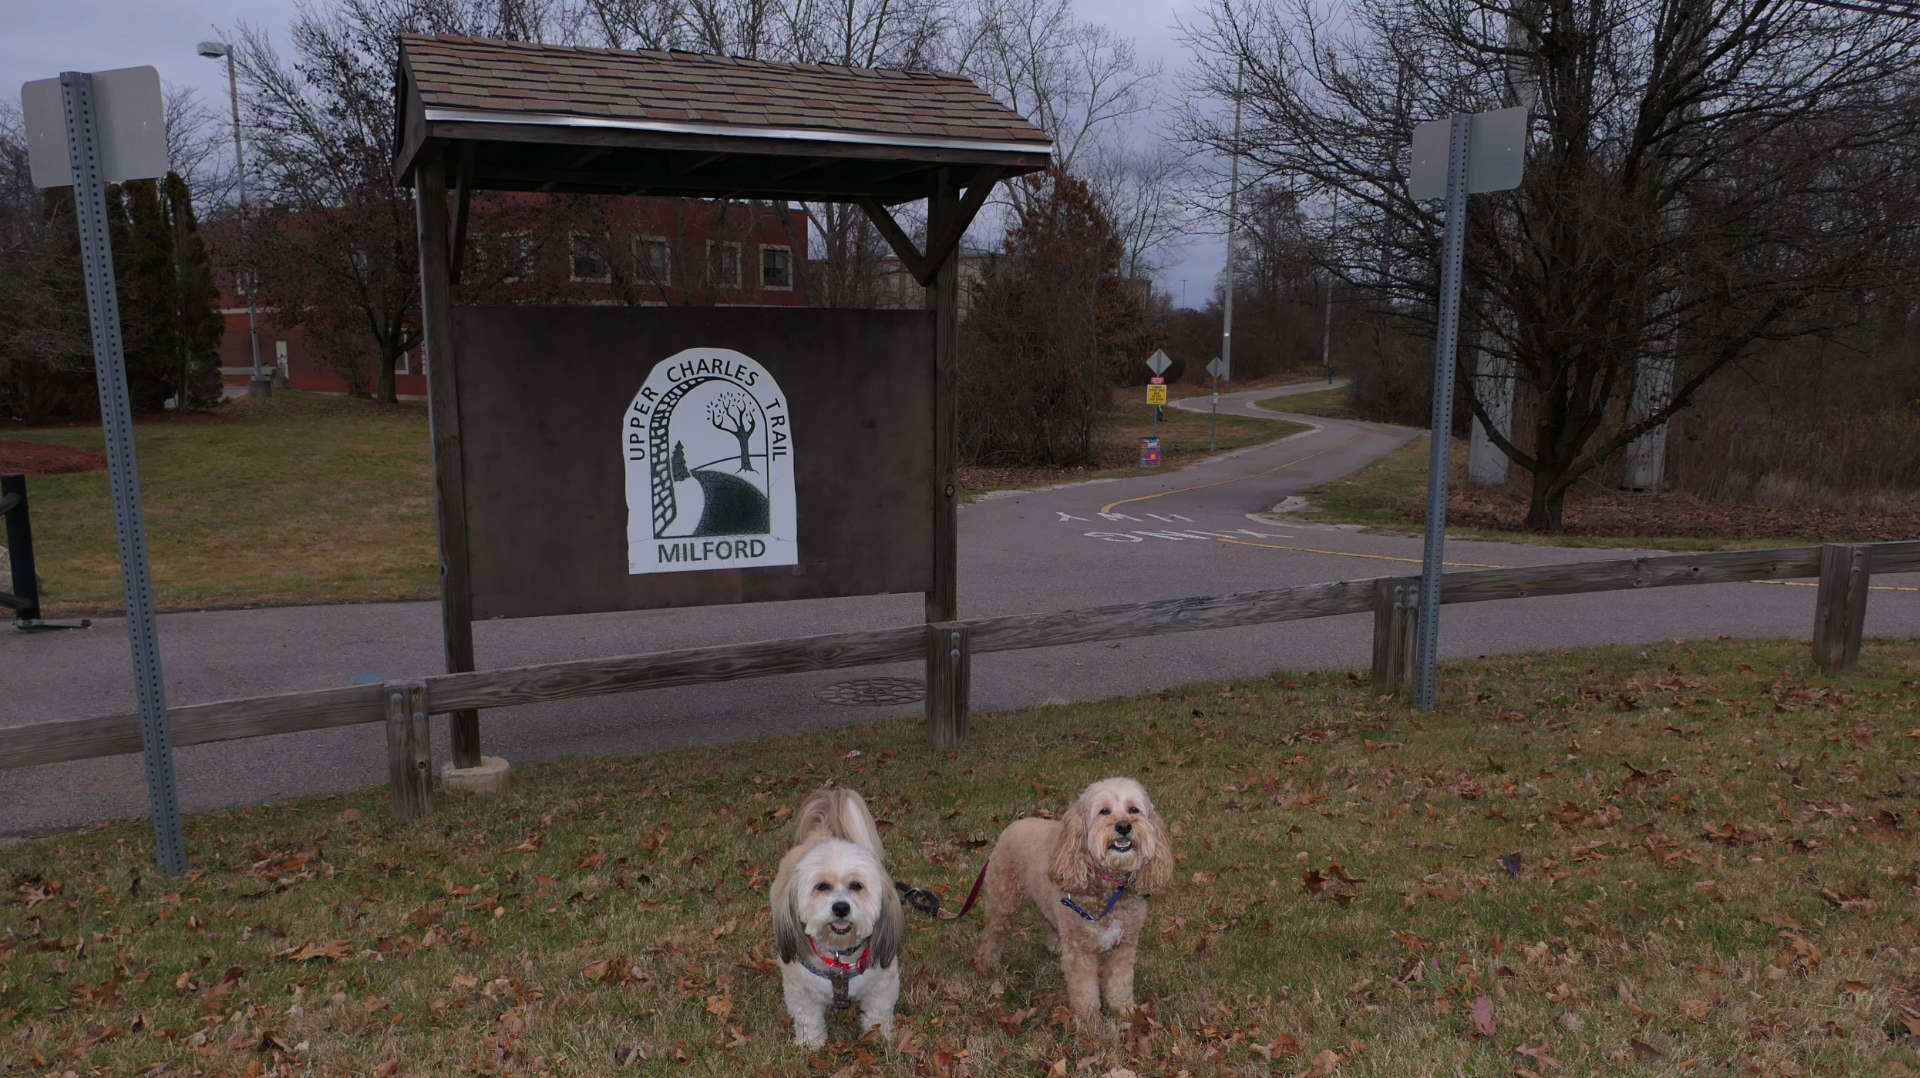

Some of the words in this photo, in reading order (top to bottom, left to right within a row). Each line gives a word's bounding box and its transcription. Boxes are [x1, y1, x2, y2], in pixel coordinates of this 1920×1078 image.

[629, 386, 659, 461] UPPER
[666, 358, 759, 387] CHARLES
[766, 398, 787, 462] TRAIL
[657, 539, 766, 563] MILFORD
